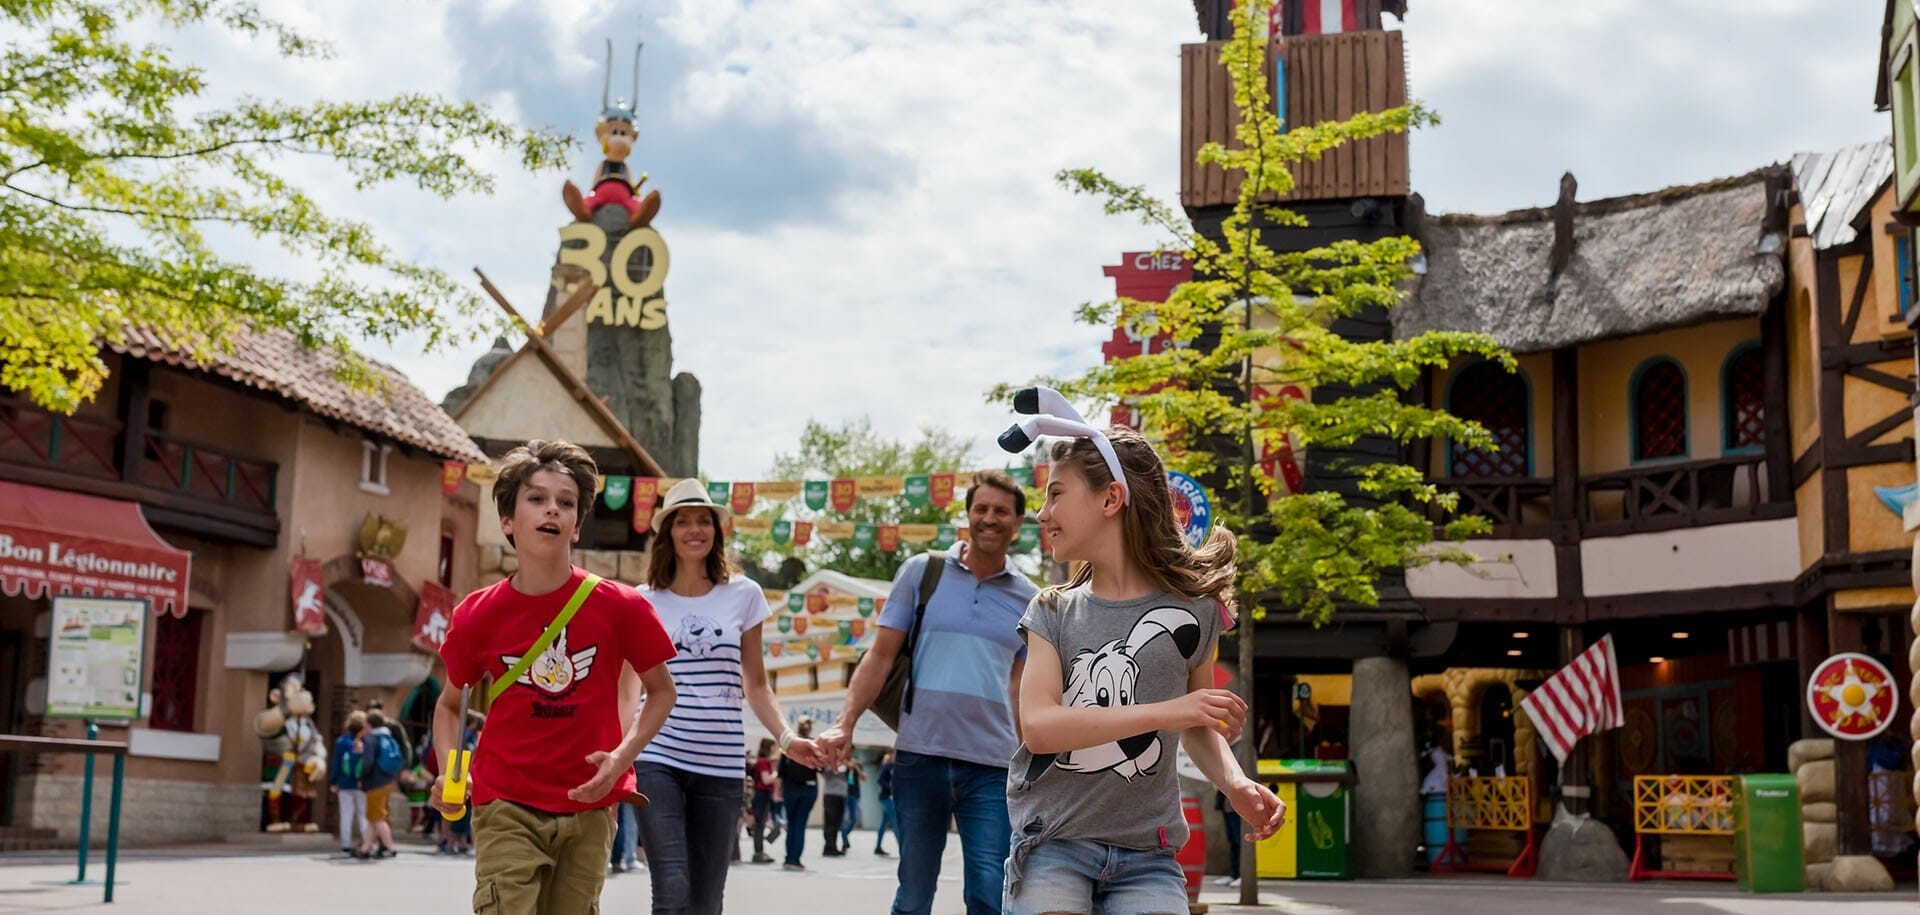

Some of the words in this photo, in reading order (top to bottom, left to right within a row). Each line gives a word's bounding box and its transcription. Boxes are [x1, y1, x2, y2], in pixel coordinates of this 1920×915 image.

[555, 221, 670, 299] 30
[1134, 253, 1182, 271] CHEZ
[586, 287, 668, 330] ANS
[0, 533, 43, 563] Bon
[48, 541, 178, 583] Légionnaire
